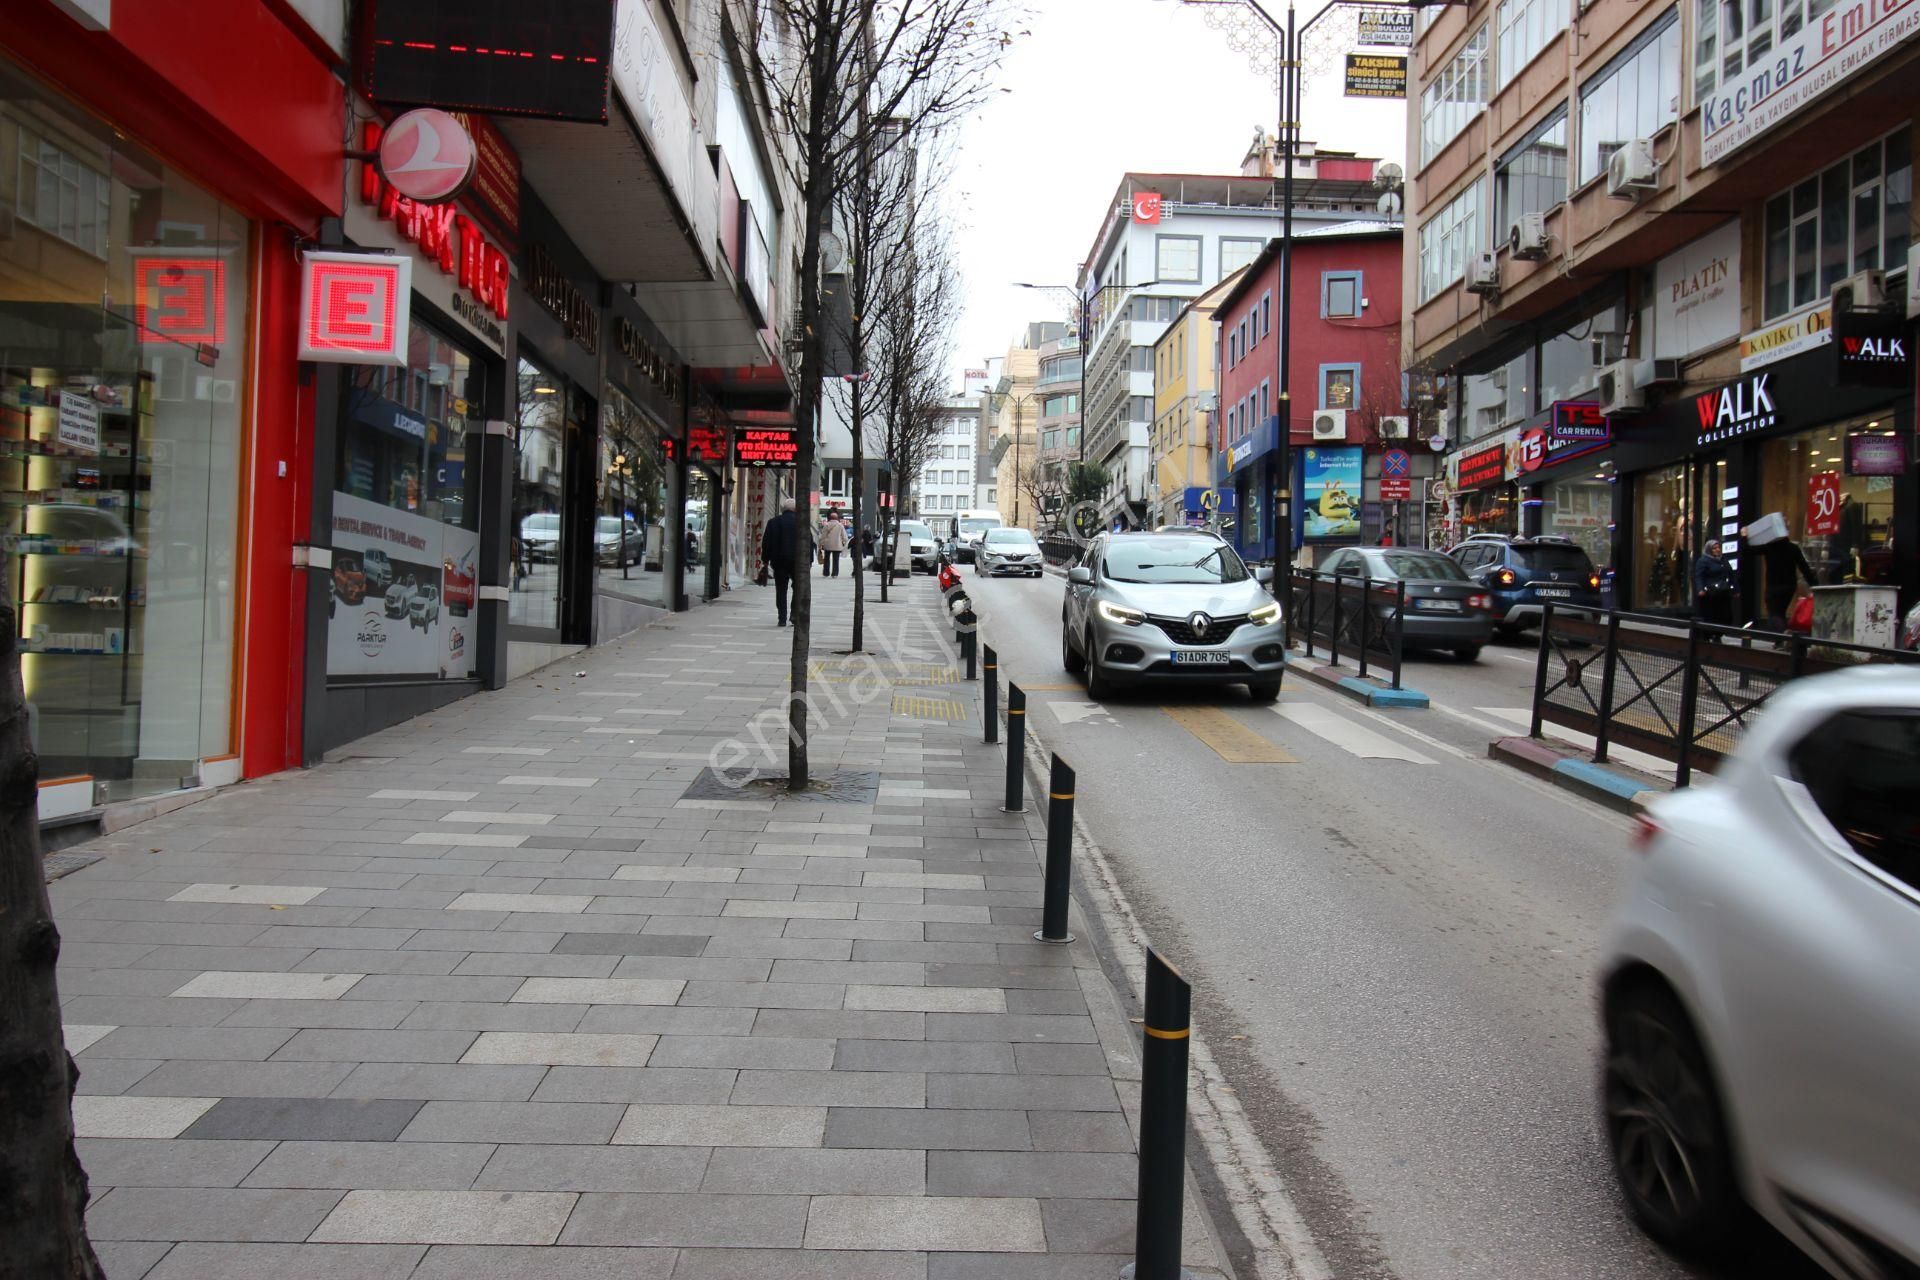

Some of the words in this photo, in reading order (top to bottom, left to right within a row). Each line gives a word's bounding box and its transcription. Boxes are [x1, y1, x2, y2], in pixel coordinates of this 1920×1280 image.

[1361, 13, 1412, 25] AVUKAT
[1354, 57, 1399, 68] TAKSİM
[1348, 67, 1378, 77] SÜRÜCÜ
[1380, 70, 1405, 78] KURSU
[1704, 46, 1805, 136] Kaçmaz
[1754, 114, 1765, 130] EN
[1802, 67, 1838, 98] ULUSAL
[1841, 41, 1874, 73] EMLAK
[456, 213, 510, 321] TUR
[1672, 257, 1728, 304] PLATİN
[328, 279, 376, 336] E
[1750, 322, 1800, 354] KAYIKÇI
[1843, 337, 1905, 357] WALK
[1696, 373, 1773, 430] WALK
[1561, 406, 1605, 425] TS
[746, 431, 790, 441] KAPTAN
[1557, 427, 1574, 435] CAR
[1574, 428, 1605, 436] RENTAL
[1698, 415, 1774, 445] COLLECTION
[737, 442, 754, 450] OTO
[754, 441, 797, 451] KİRALAMA
[741, 451, 765, 460] RENT
[766, 452, 773, 460] A
[775, 452, 792, 460] CAR
[1520, 434, 1542, 462] TS
[357, 632, 386, 643] PARKTUR
[1177, 652, 1208, 663] 61ADR
[1210, 652, 1229, 663] 705
